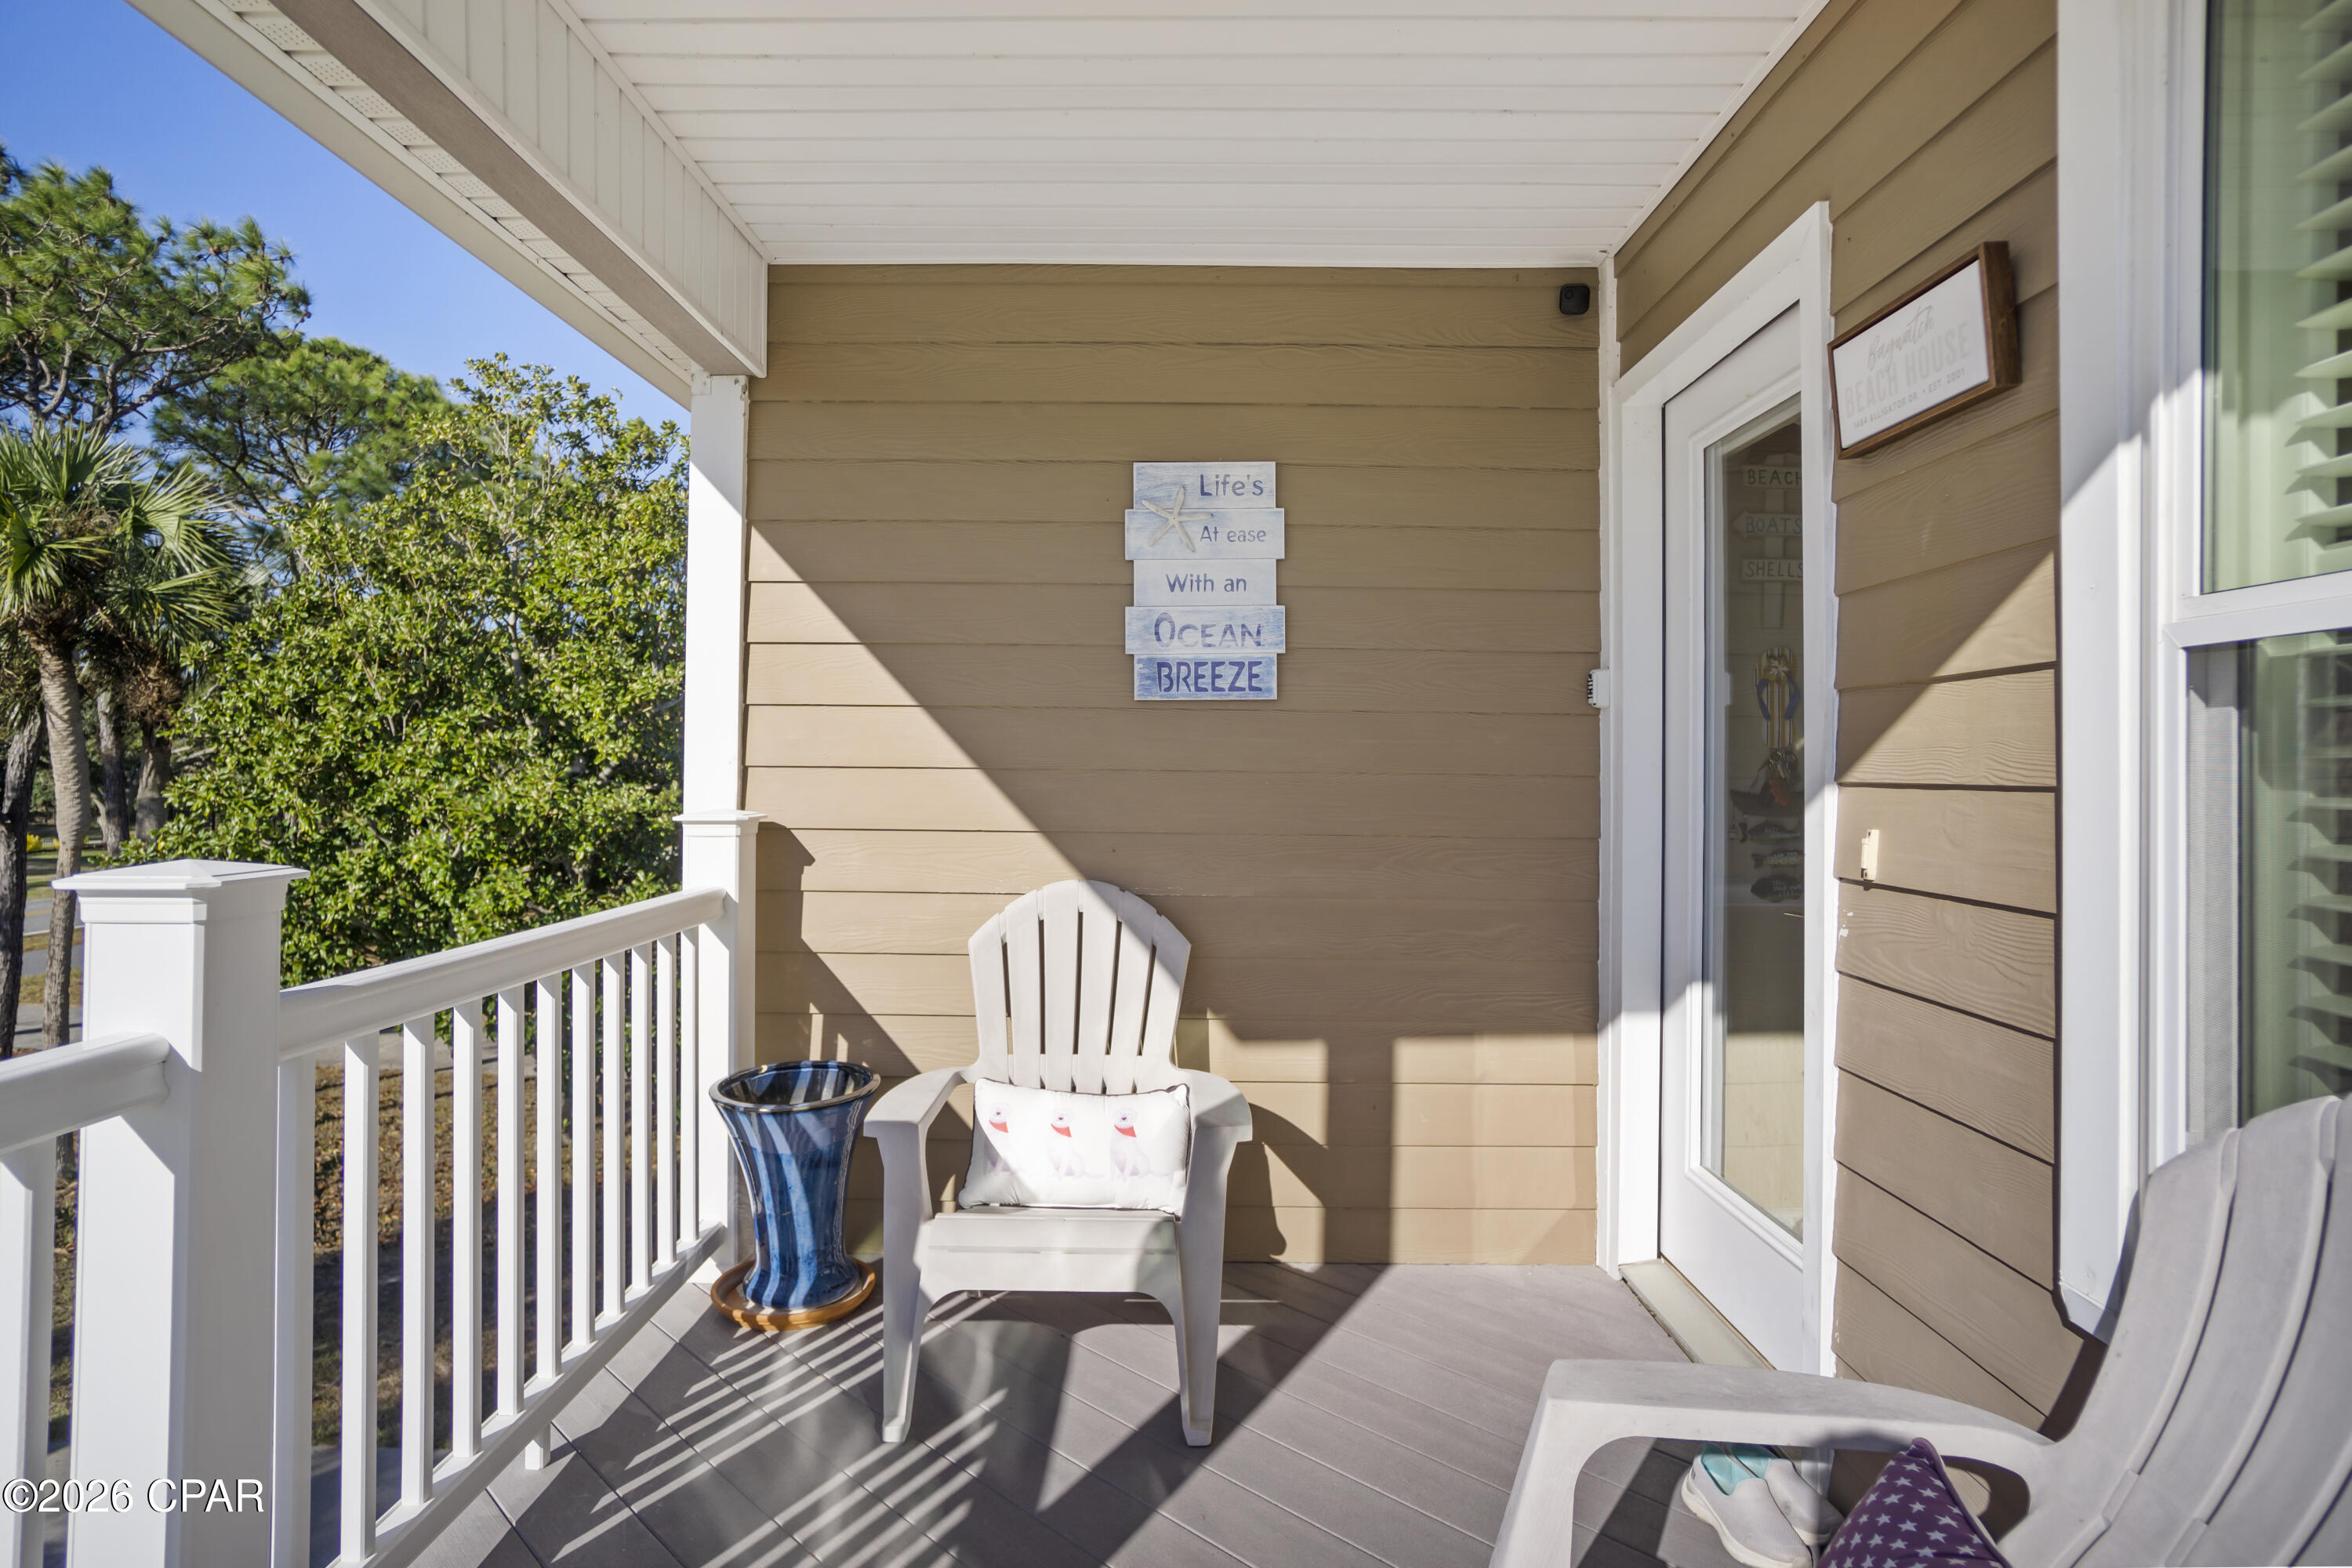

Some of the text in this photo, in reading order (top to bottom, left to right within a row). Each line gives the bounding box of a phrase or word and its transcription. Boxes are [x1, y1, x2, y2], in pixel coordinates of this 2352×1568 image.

[1844, 321, 1970, 419] BEACH HOUSE
[1869, 397, 1907, 423] ALLIGATOR
[1200, 474, 1264, 496] Life's
[1747, 469, 1802, 486] BEACH
[1200, 525, 1267, 543] At ease
[1745, 516, 1802, 534] BOATS
[1165, 573, 1247, 593] With an
[1154, 612, 1265, 648] OCEAN
[1156, 660, 1263, 693] BREEZE
